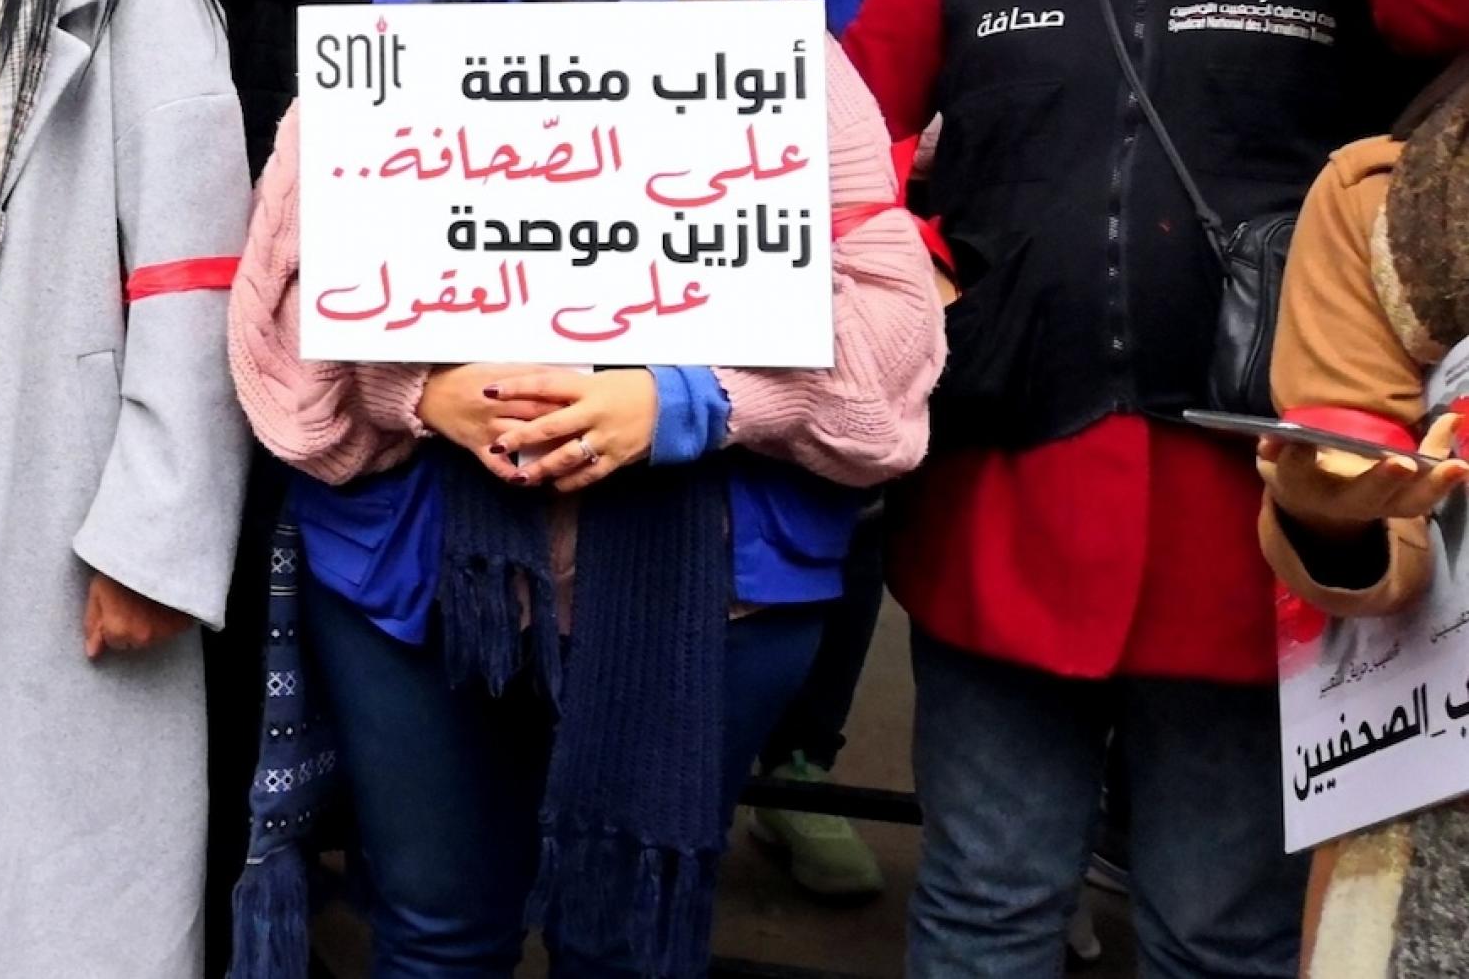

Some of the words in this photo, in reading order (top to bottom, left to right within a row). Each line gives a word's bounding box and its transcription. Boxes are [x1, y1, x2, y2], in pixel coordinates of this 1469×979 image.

[977, 6, 1065, 37] صحافة
[316, 16, 406, 106] snjt
[461, 53, 631, 103] مغلقة
[653, 40, 807, 116] أبواب
[645, 124, 810, 208] على
[447, 205, 640, 267] موصدة
[662, 204, 813, 269] زنازين
[315, 260, 531, 332] العقول
[551, 260, 711, 343] على
